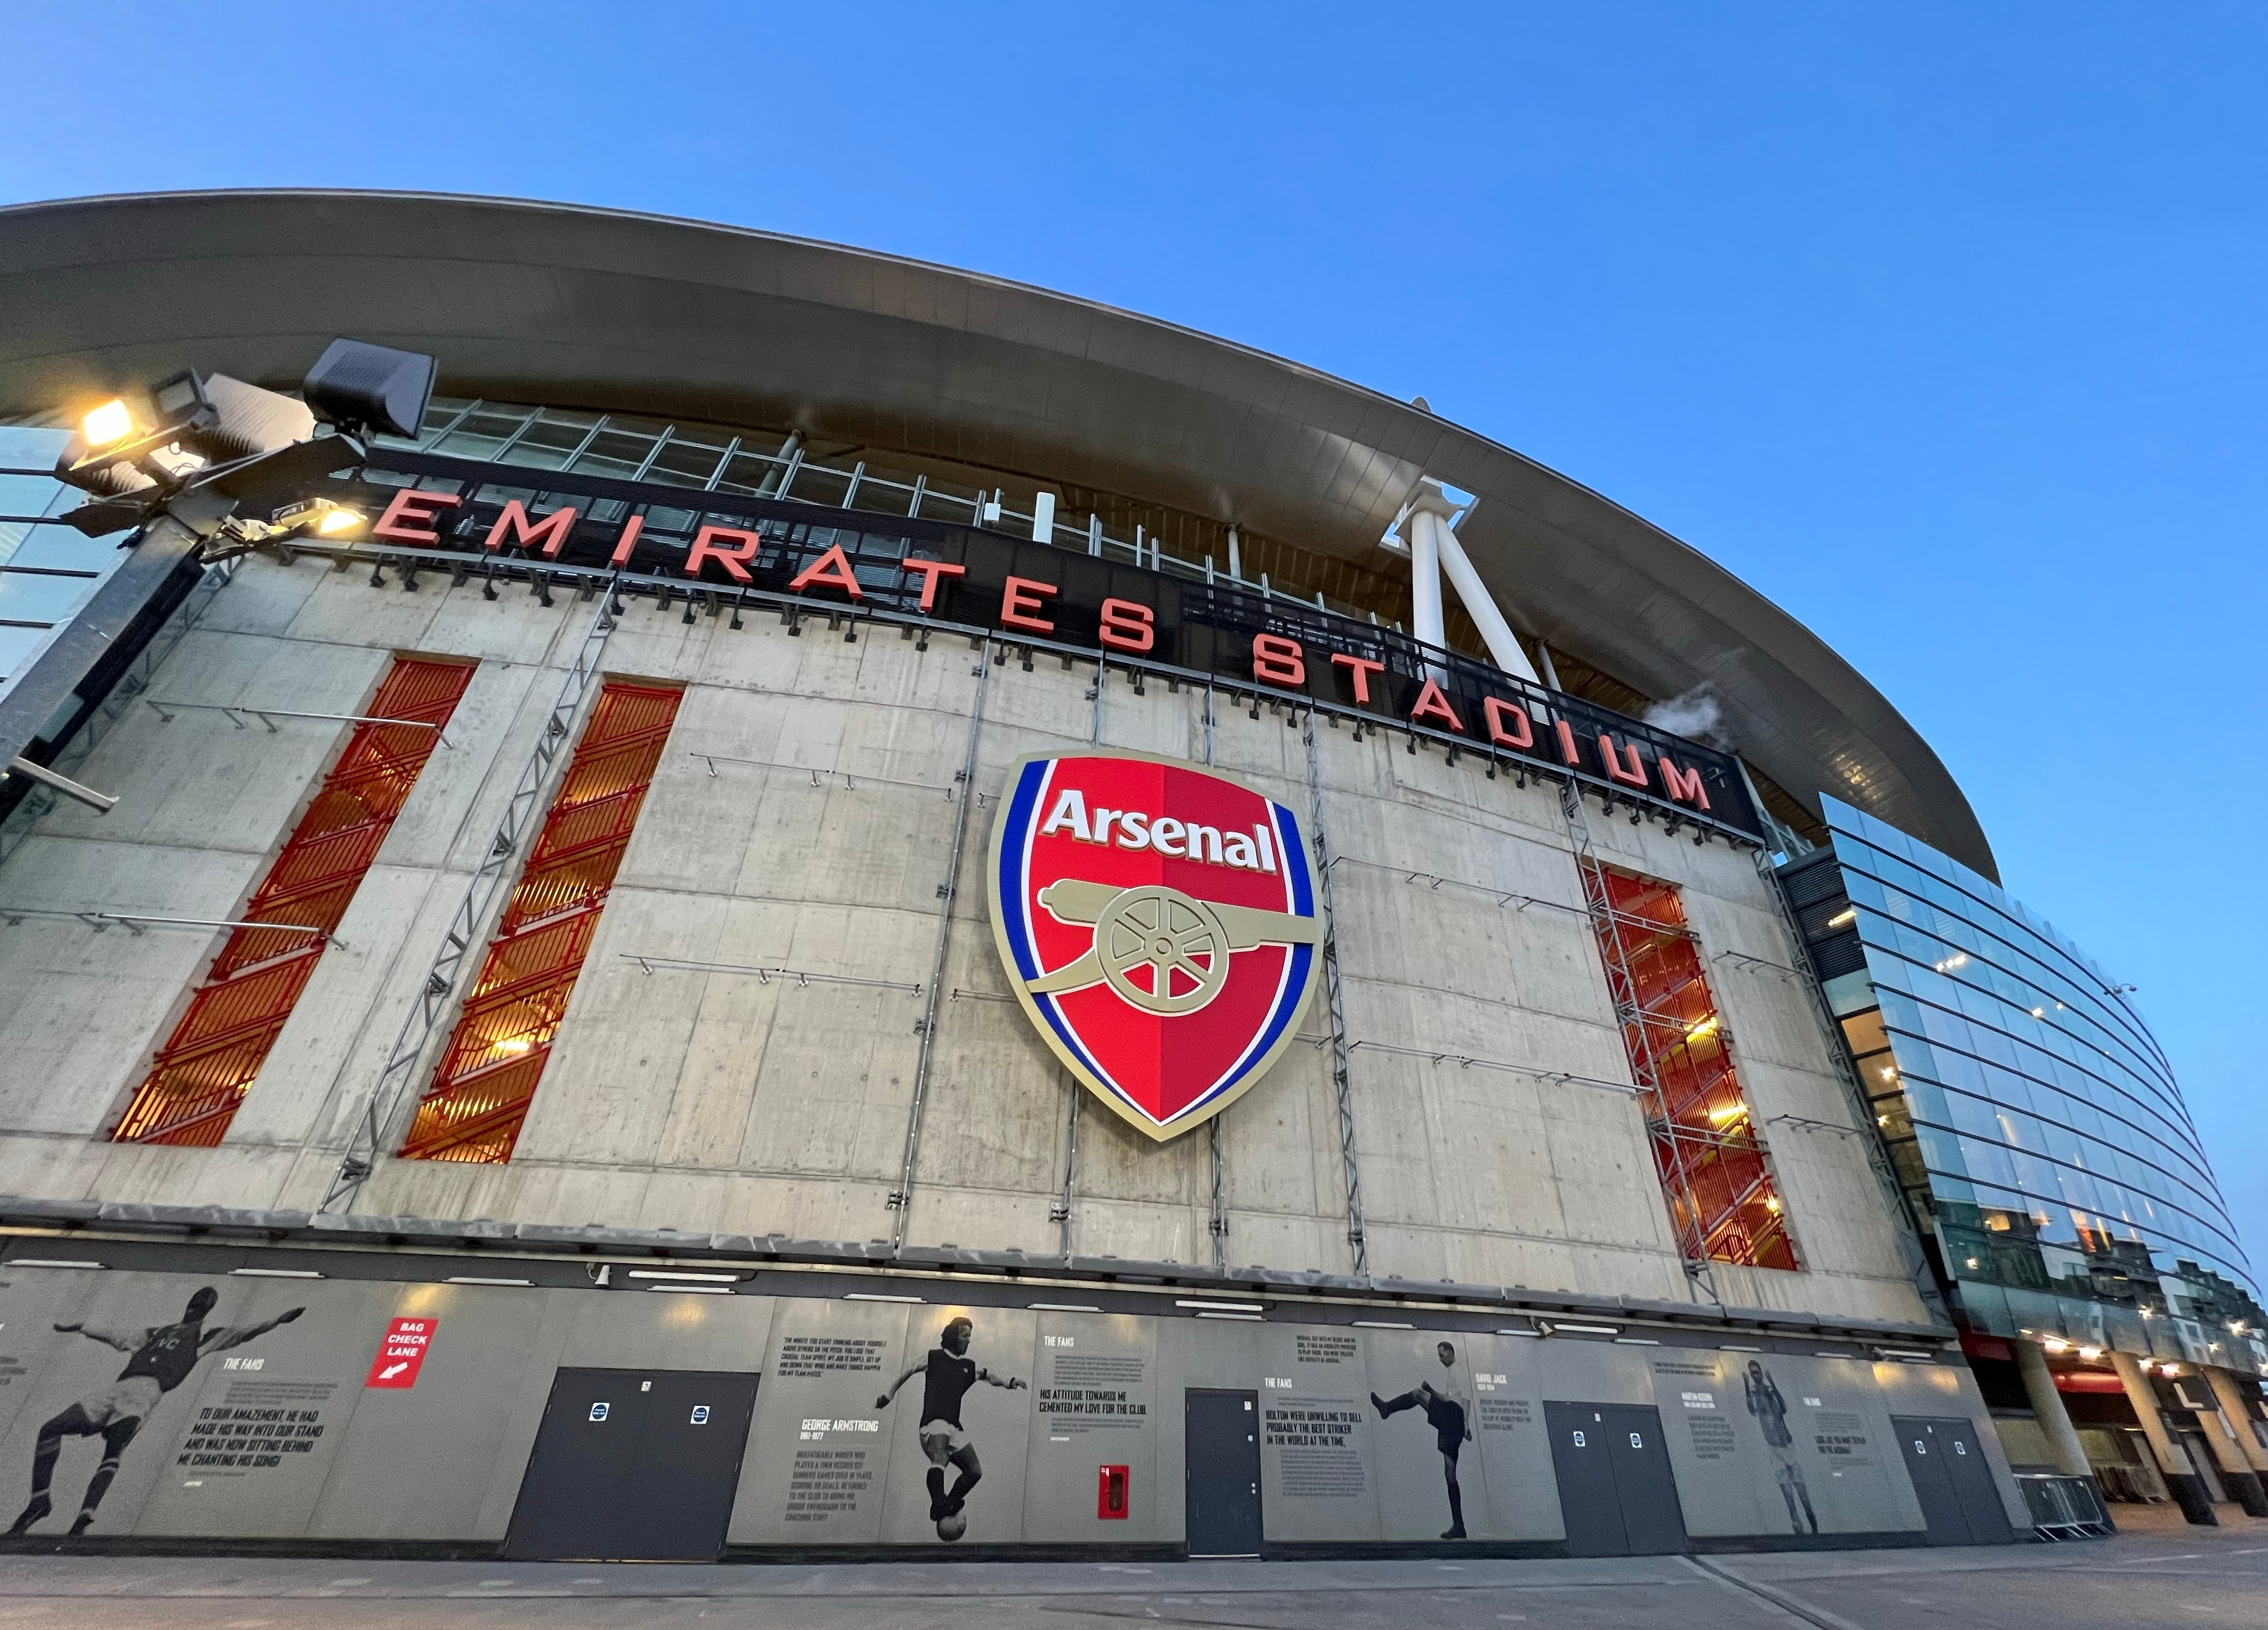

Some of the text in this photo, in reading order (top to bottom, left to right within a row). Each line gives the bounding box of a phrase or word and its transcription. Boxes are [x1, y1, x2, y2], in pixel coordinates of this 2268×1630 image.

[372, 489, 1711, 810] EMIRATES STADIUM
[1039, 789, 1277, 875] Arsenal
[400, 1323, 424, 1332] BAG
[388, 1334, 428, 1344] CHECK
[1044, 1336, 1074, 1347] THE FANS
[387, 1347, 419, 1356] LANE
[223, 1358, 264, 1370] THE FANS
[1265, 1378, 1292, 1389] THE FANS
[1492, 1374, 1507, 1384] JACK
[1040, 1389, 1127, 1402] HIS ATTITUDE TOWARDS ME
[200, 1408, 213, 1419] TO
[212, 1408, 232, 1420] OUR
[286, 1410, 299, 1422] HE
[299, 1410, 318, 1422] HAD
[1039, 1402, 1147, 1415] CEMENTED MY LOVE FOR THE CLUB.
[1266, 1410, 1362, 1423] BOLTON WERE UNWILLING TO SELL
[191, 1423, 324, 1437] MADE HIS WAY INTO OUR STAND
[801, 1419, 879, 1432] GEORGE ARMSTRONG
[1266, 1422, 1352, 1434] PROBABLY THE BEST STRIKER
[184, 1438, 313, 1452] AND WAS NOW SITTING BEHIND
[1267, 1434, 1273, 1445] IN
[1275, 1435, 1285, 1445] THE
[1287, 1435, 1308, 1446] WORLD
[1310, 1436, 1318, 1446] AT
[1319, 1436, 1330, 1446] THE
[177, 1453, 192, 1465] ME
[192, 1454, 236, 1466] CHANTING
[236, 1454, 254, 1467] HIS
